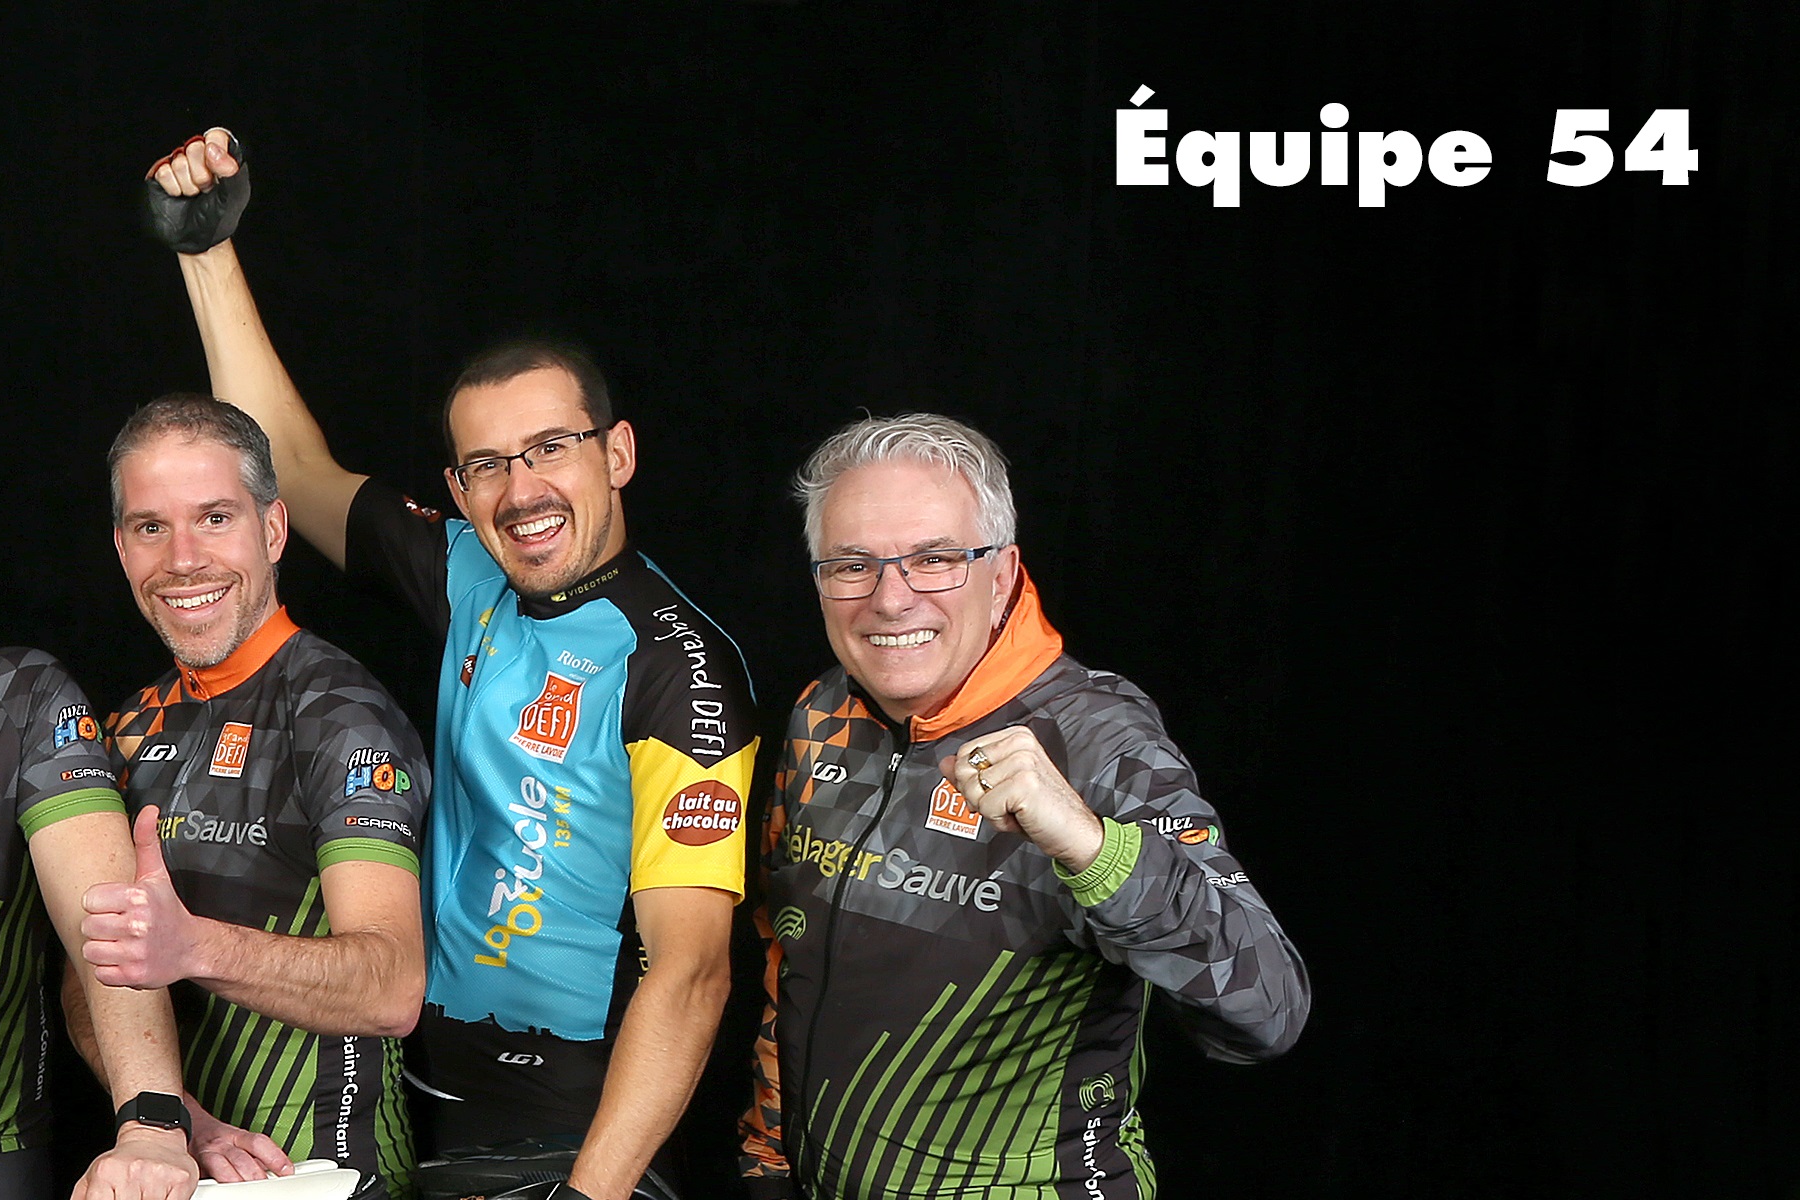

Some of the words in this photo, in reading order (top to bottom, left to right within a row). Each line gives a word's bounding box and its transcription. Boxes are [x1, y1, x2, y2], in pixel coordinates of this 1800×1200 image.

[654, 621, 722, 690] grand
[347, 747, 390, 770] Allez
[345, 763, 411, 797] HOP
[553, 785, 573, 815] KM
[678, 792, 712, 812] lait
[713, 797, 737, 813] au
[553, 820, 572, 848] 135
[662, 812, 739, 832] chocolat
[952, 821, 977, 836] LAVOIE
